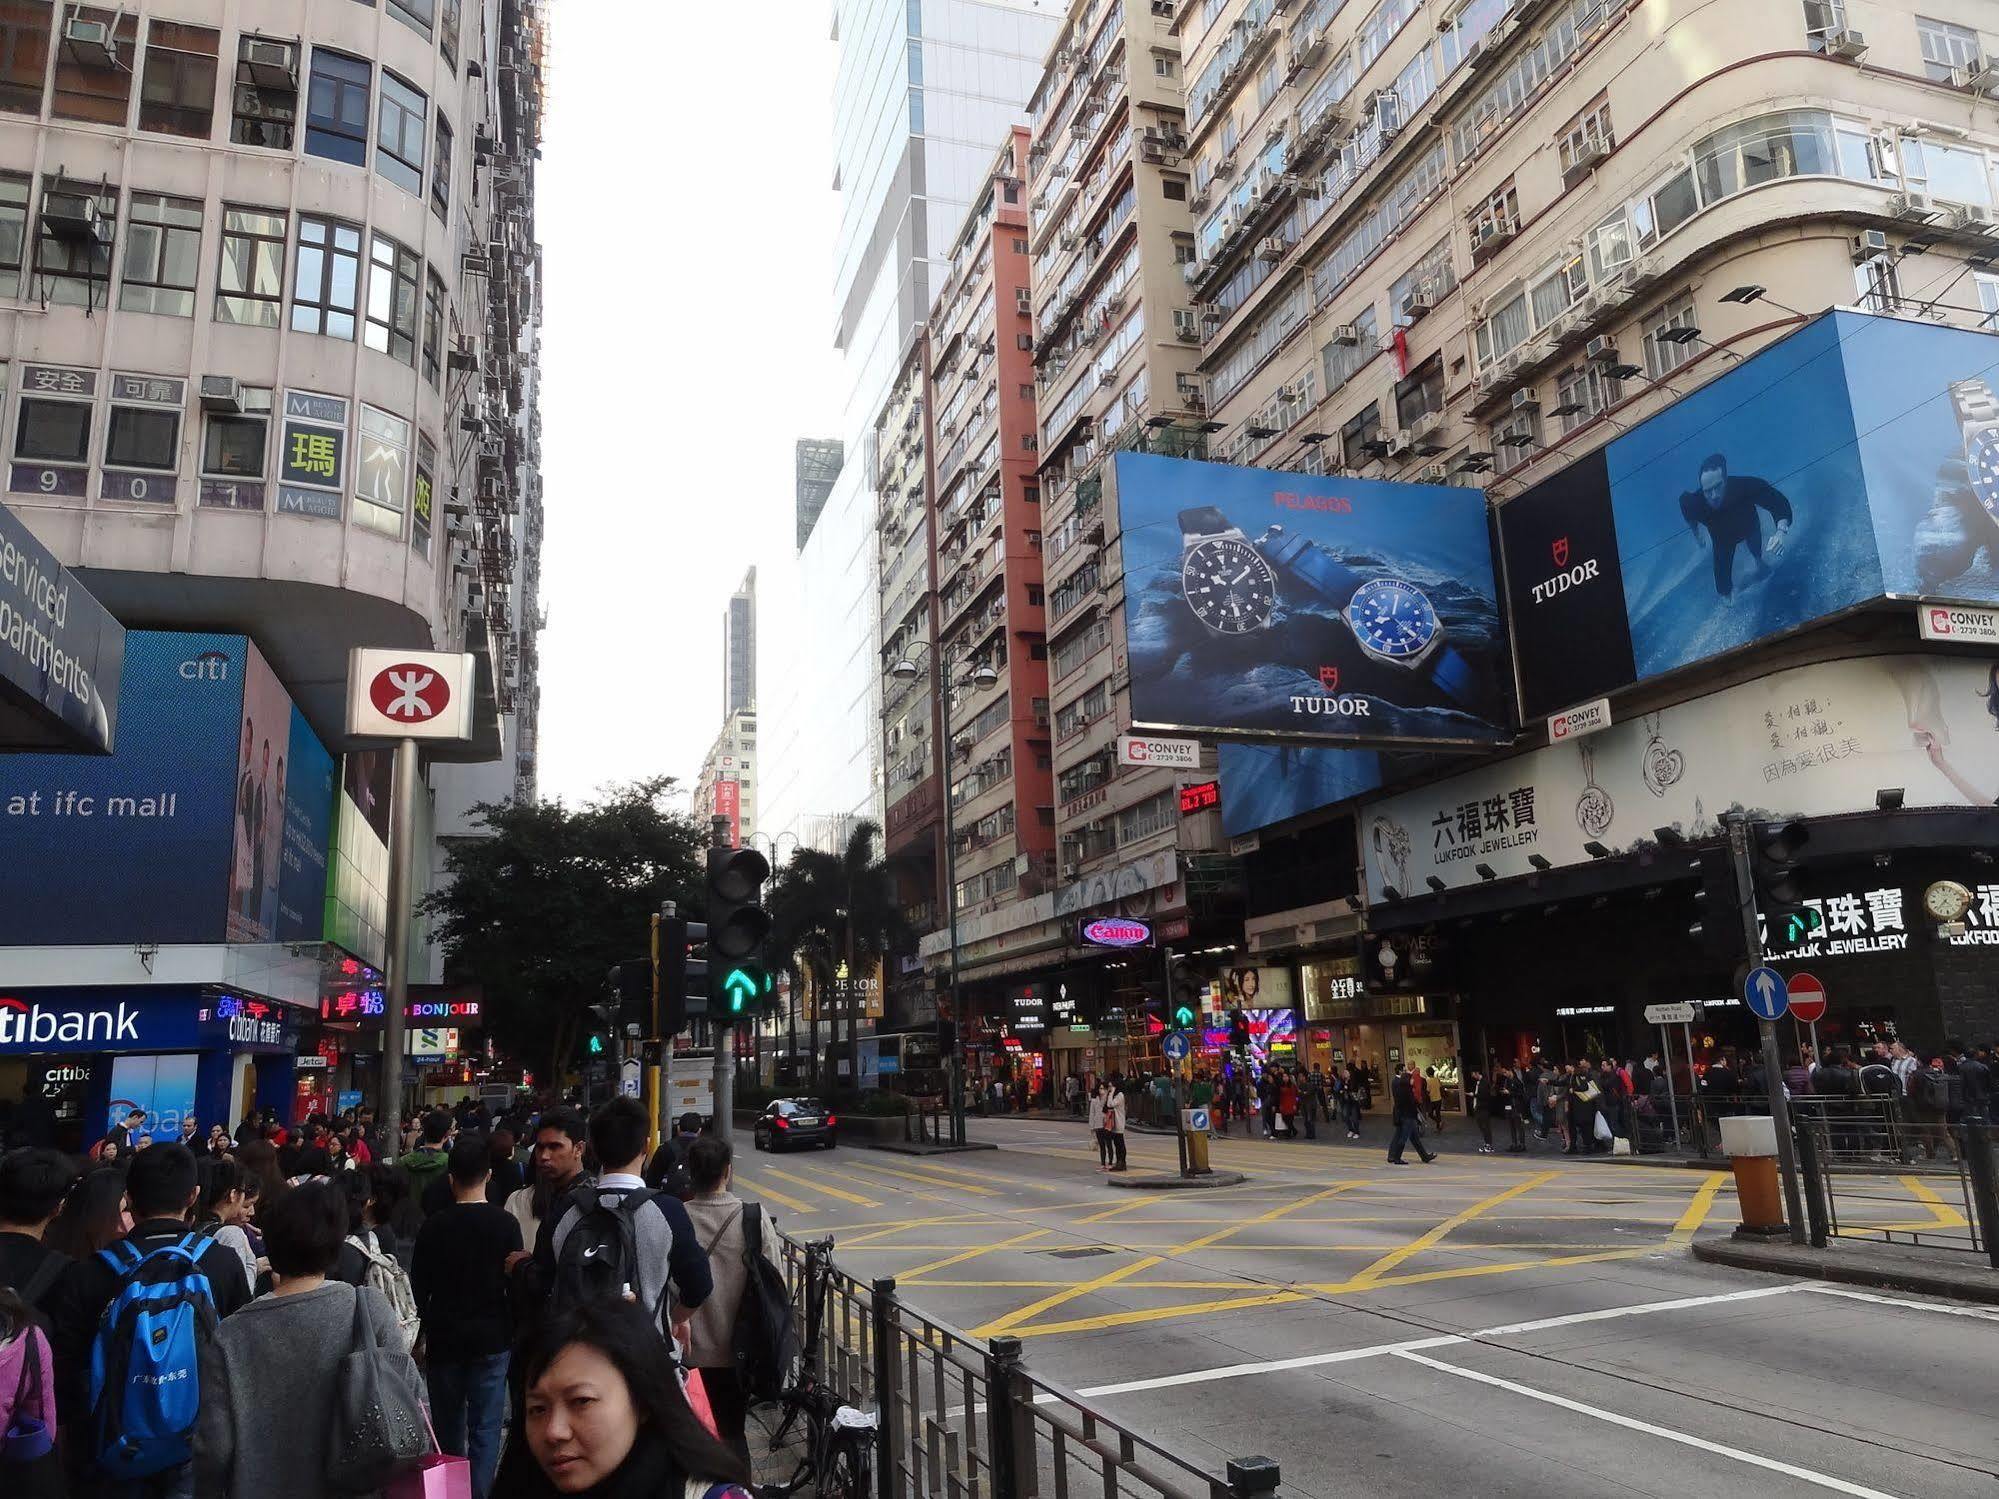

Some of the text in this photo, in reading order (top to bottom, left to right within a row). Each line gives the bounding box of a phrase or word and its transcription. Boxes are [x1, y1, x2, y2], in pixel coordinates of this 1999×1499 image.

[35, 370, 173, 401] 安全 可靠
[290, 432, 336, 477] 瑪
[40, 469, 58, 492] 9
[1273, 491, 1352, 513] PELAGOS
[1532, 558, 1599, 604] TUDOR
[1950, 612, 1993, 626] CONVEY
[179, 651, 228, 682] citi
[1290, 695, 1370, 717] TUDOR
[1567, 706, 1600, 725] CONVEY
[1147, 743, 1192, 755] CONVEY
[1763, 738, 1863, 783] 因為愛很美
[7, 790, 176, 817] at ifc mall
[1431, 786, 1536, 849] 六福珠寶
[1434, 829, 1540, 866] LUKFOOK JEWELLERY
[1090, 924, 1145, 940] Canon
[1826, 933, 1909, 955] JEWELLERY
[413, 1002, 479, 1017] BONJOUR
[1014, 998, 1044, 1007] TUDOR
